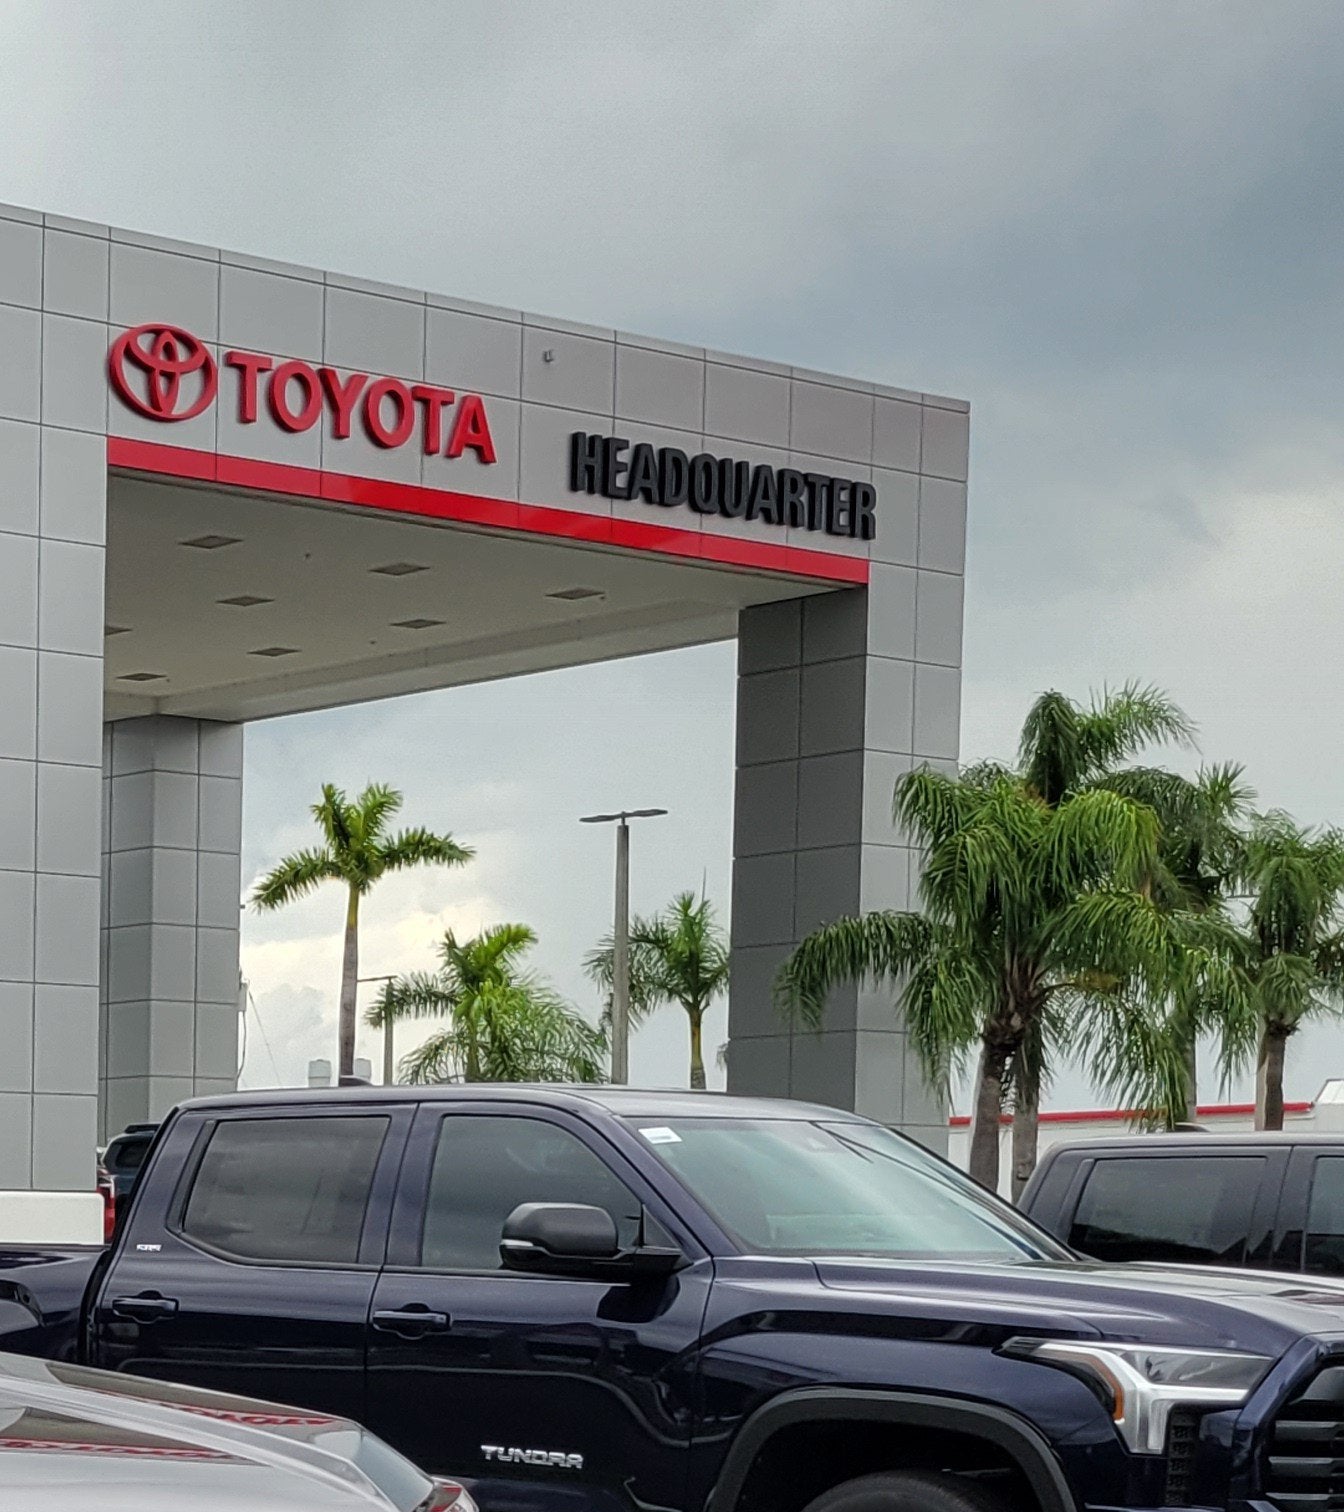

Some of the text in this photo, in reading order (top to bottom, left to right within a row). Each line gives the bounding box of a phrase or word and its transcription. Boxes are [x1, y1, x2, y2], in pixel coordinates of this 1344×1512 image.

[226, 351, 497, 465] TOYOTA
[570, 431, 877, 540] HEADQUARTER
[480, 1445, 584, 1469] TUNDRA
